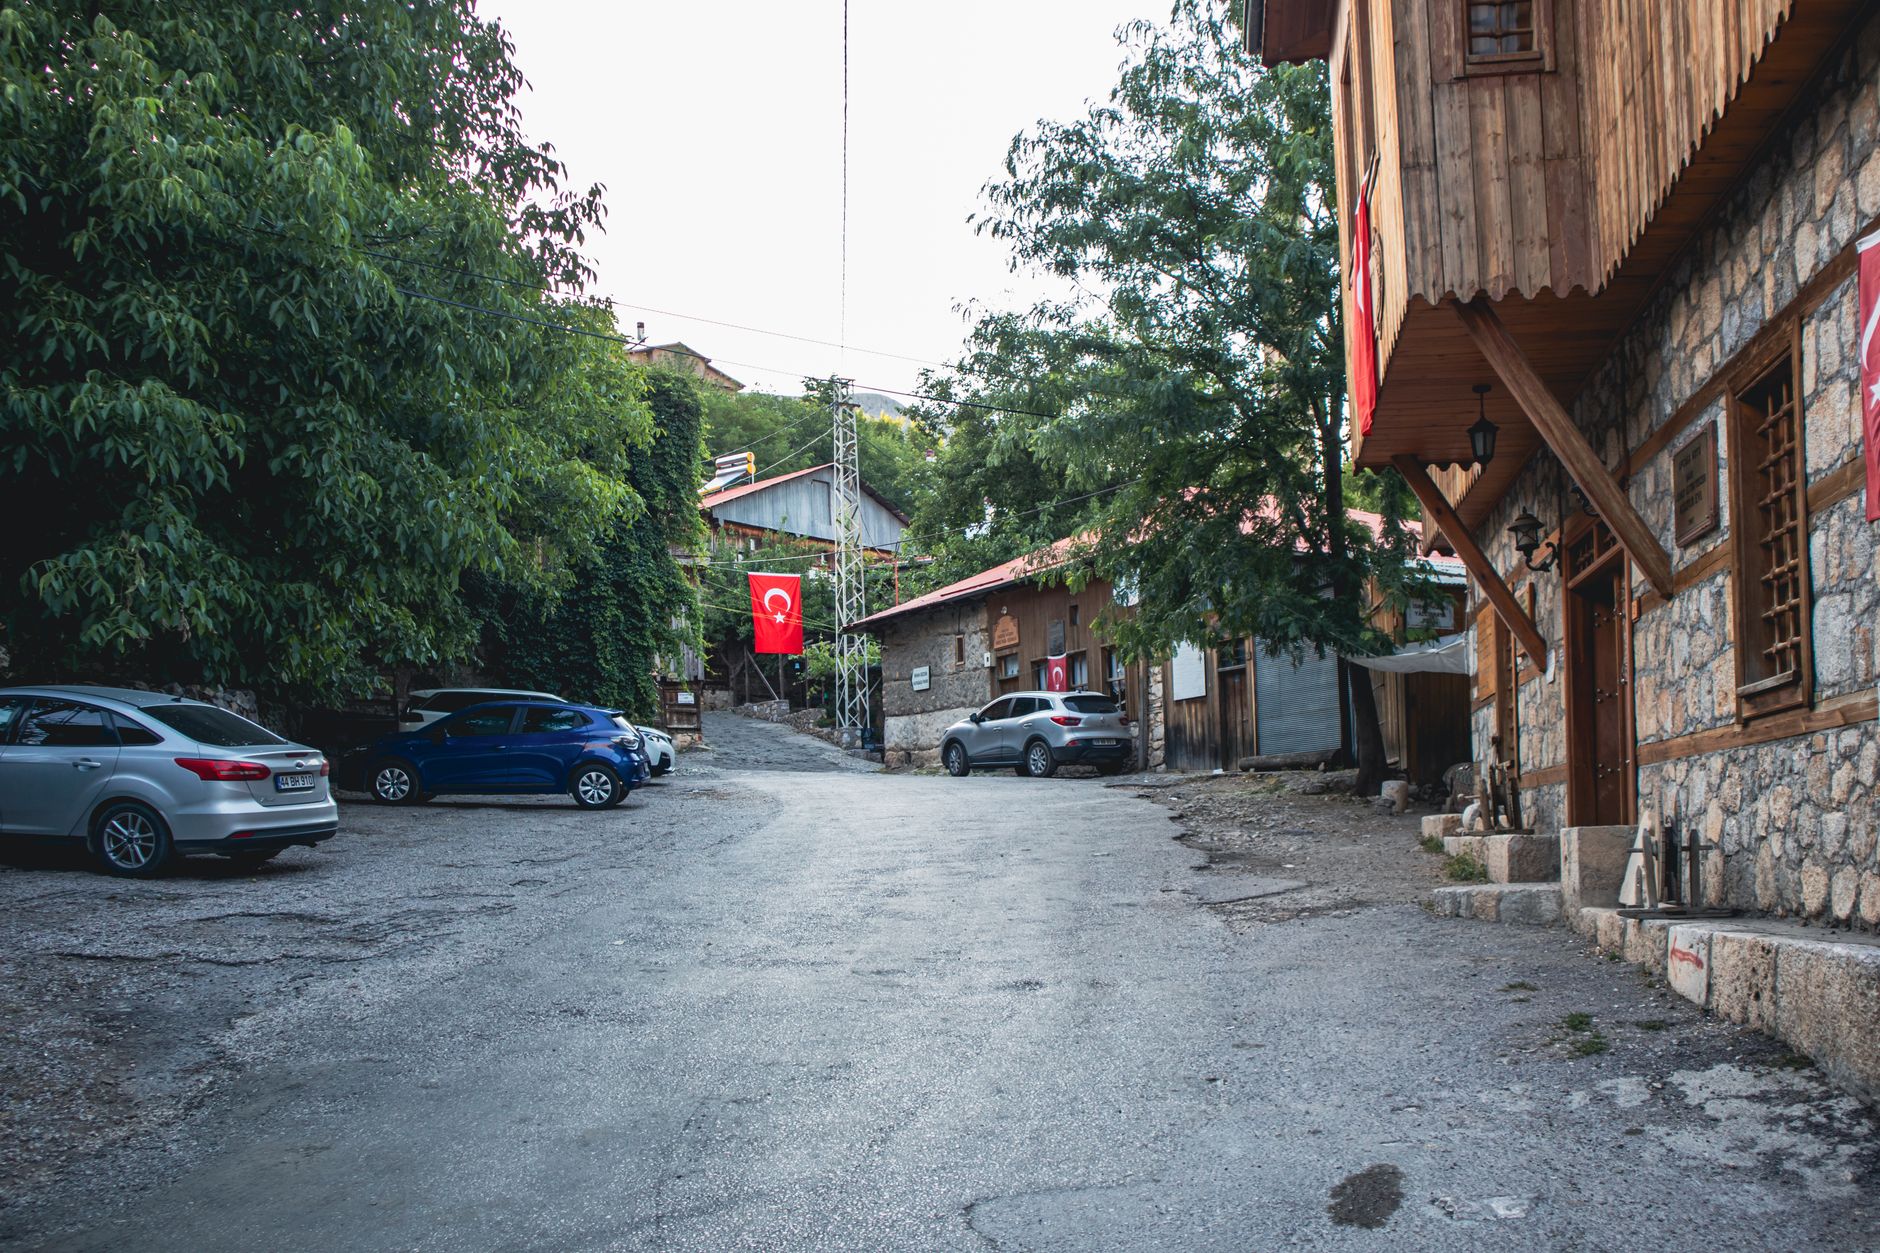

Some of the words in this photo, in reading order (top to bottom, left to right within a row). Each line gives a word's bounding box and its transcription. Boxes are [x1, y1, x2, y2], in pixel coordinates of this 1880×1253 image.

[281, 777, 289, 787] 44
[290, 776, 300, 786] BH
[301, 775, 313, 785] 910
